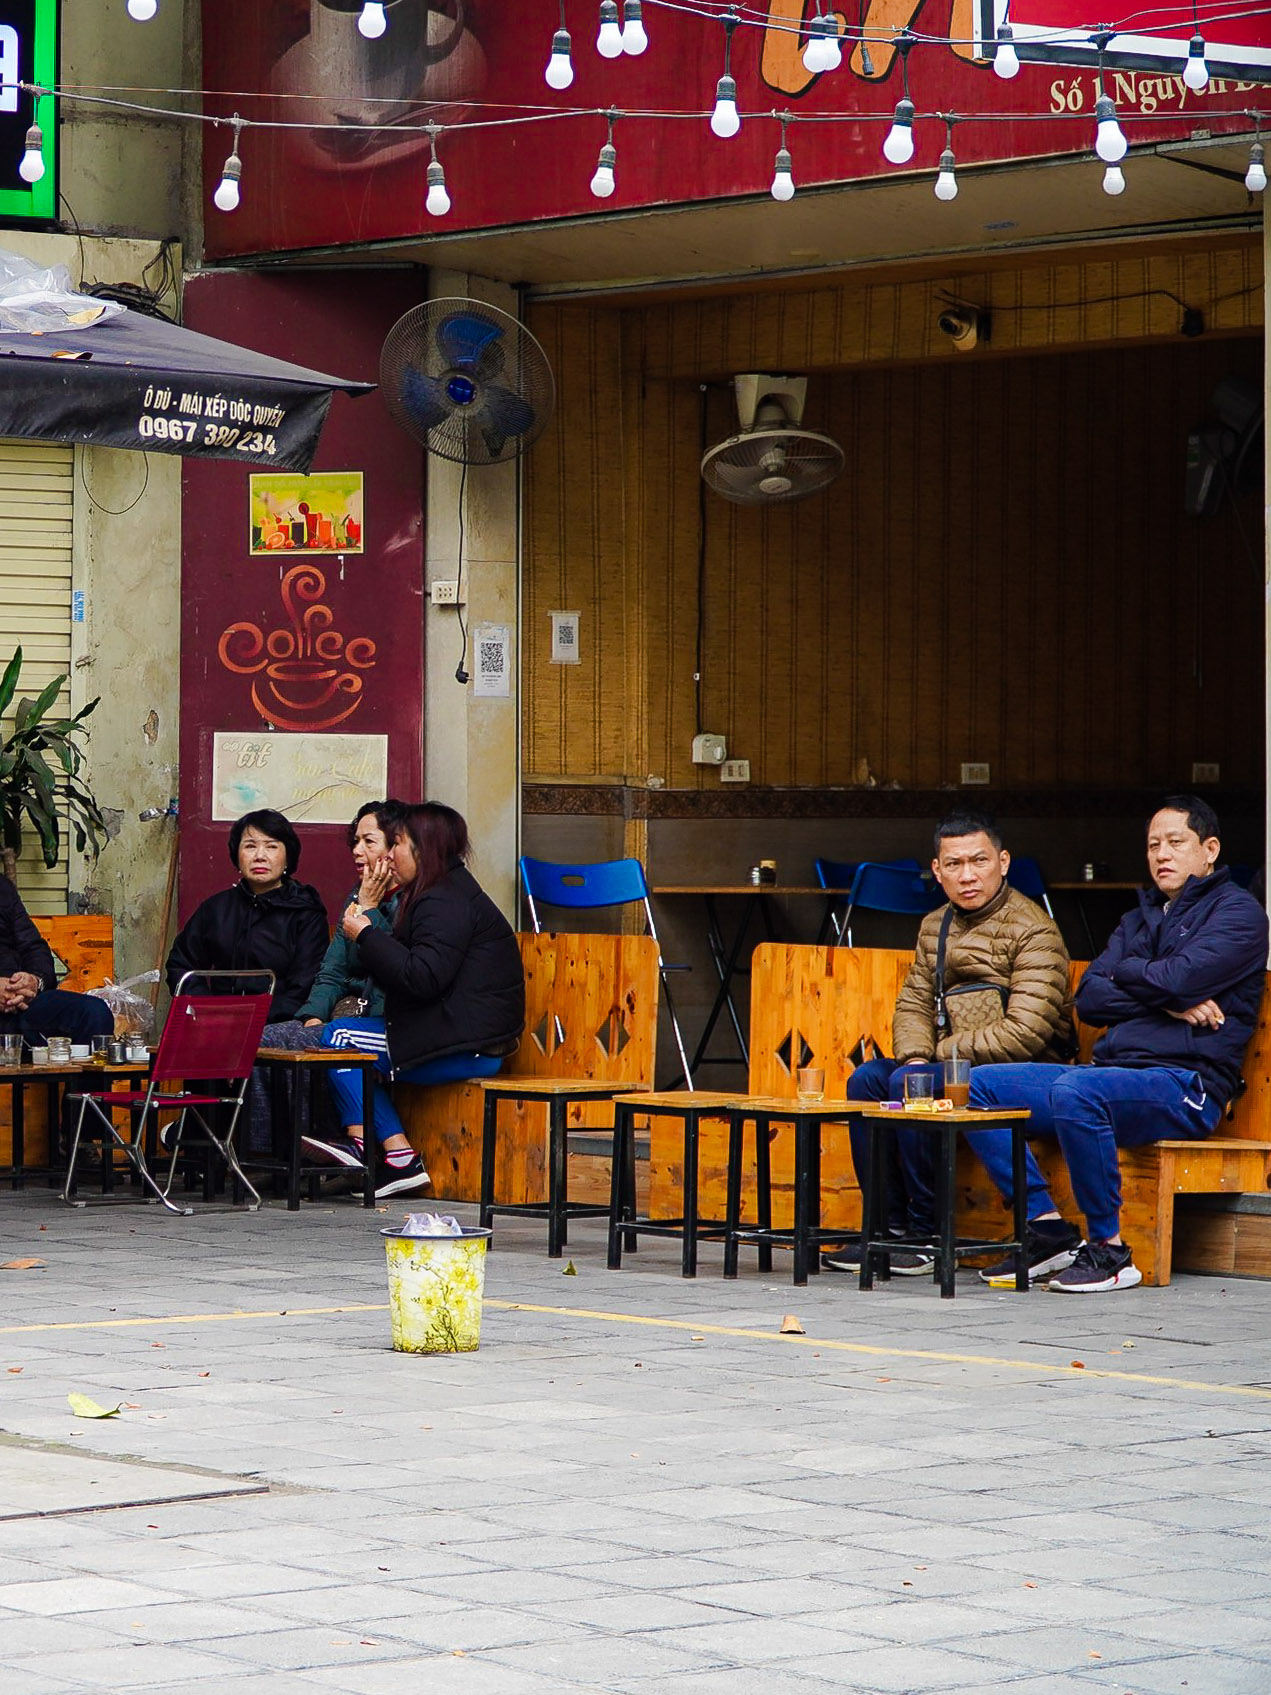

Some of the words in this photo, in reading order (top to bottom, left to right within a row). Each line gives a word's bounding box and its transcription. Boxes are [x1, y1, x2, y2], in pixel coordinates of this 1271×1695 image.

[1050, 76, 1083, 113] Số
[1112, 71, 1228, 114] Nguyn
[143, 384, 154, 408] Ô
[153, 386, 172, 411] DÙ
[179, 391, 202, 415] MÁI
[204, 393, 228, 418] XẾP
[138, 415, 197, 442] 0967
[204, 423, 239, 447] 380
[236, 430, 277, 455] 234
[218, 564, 376, 674] Coffee
